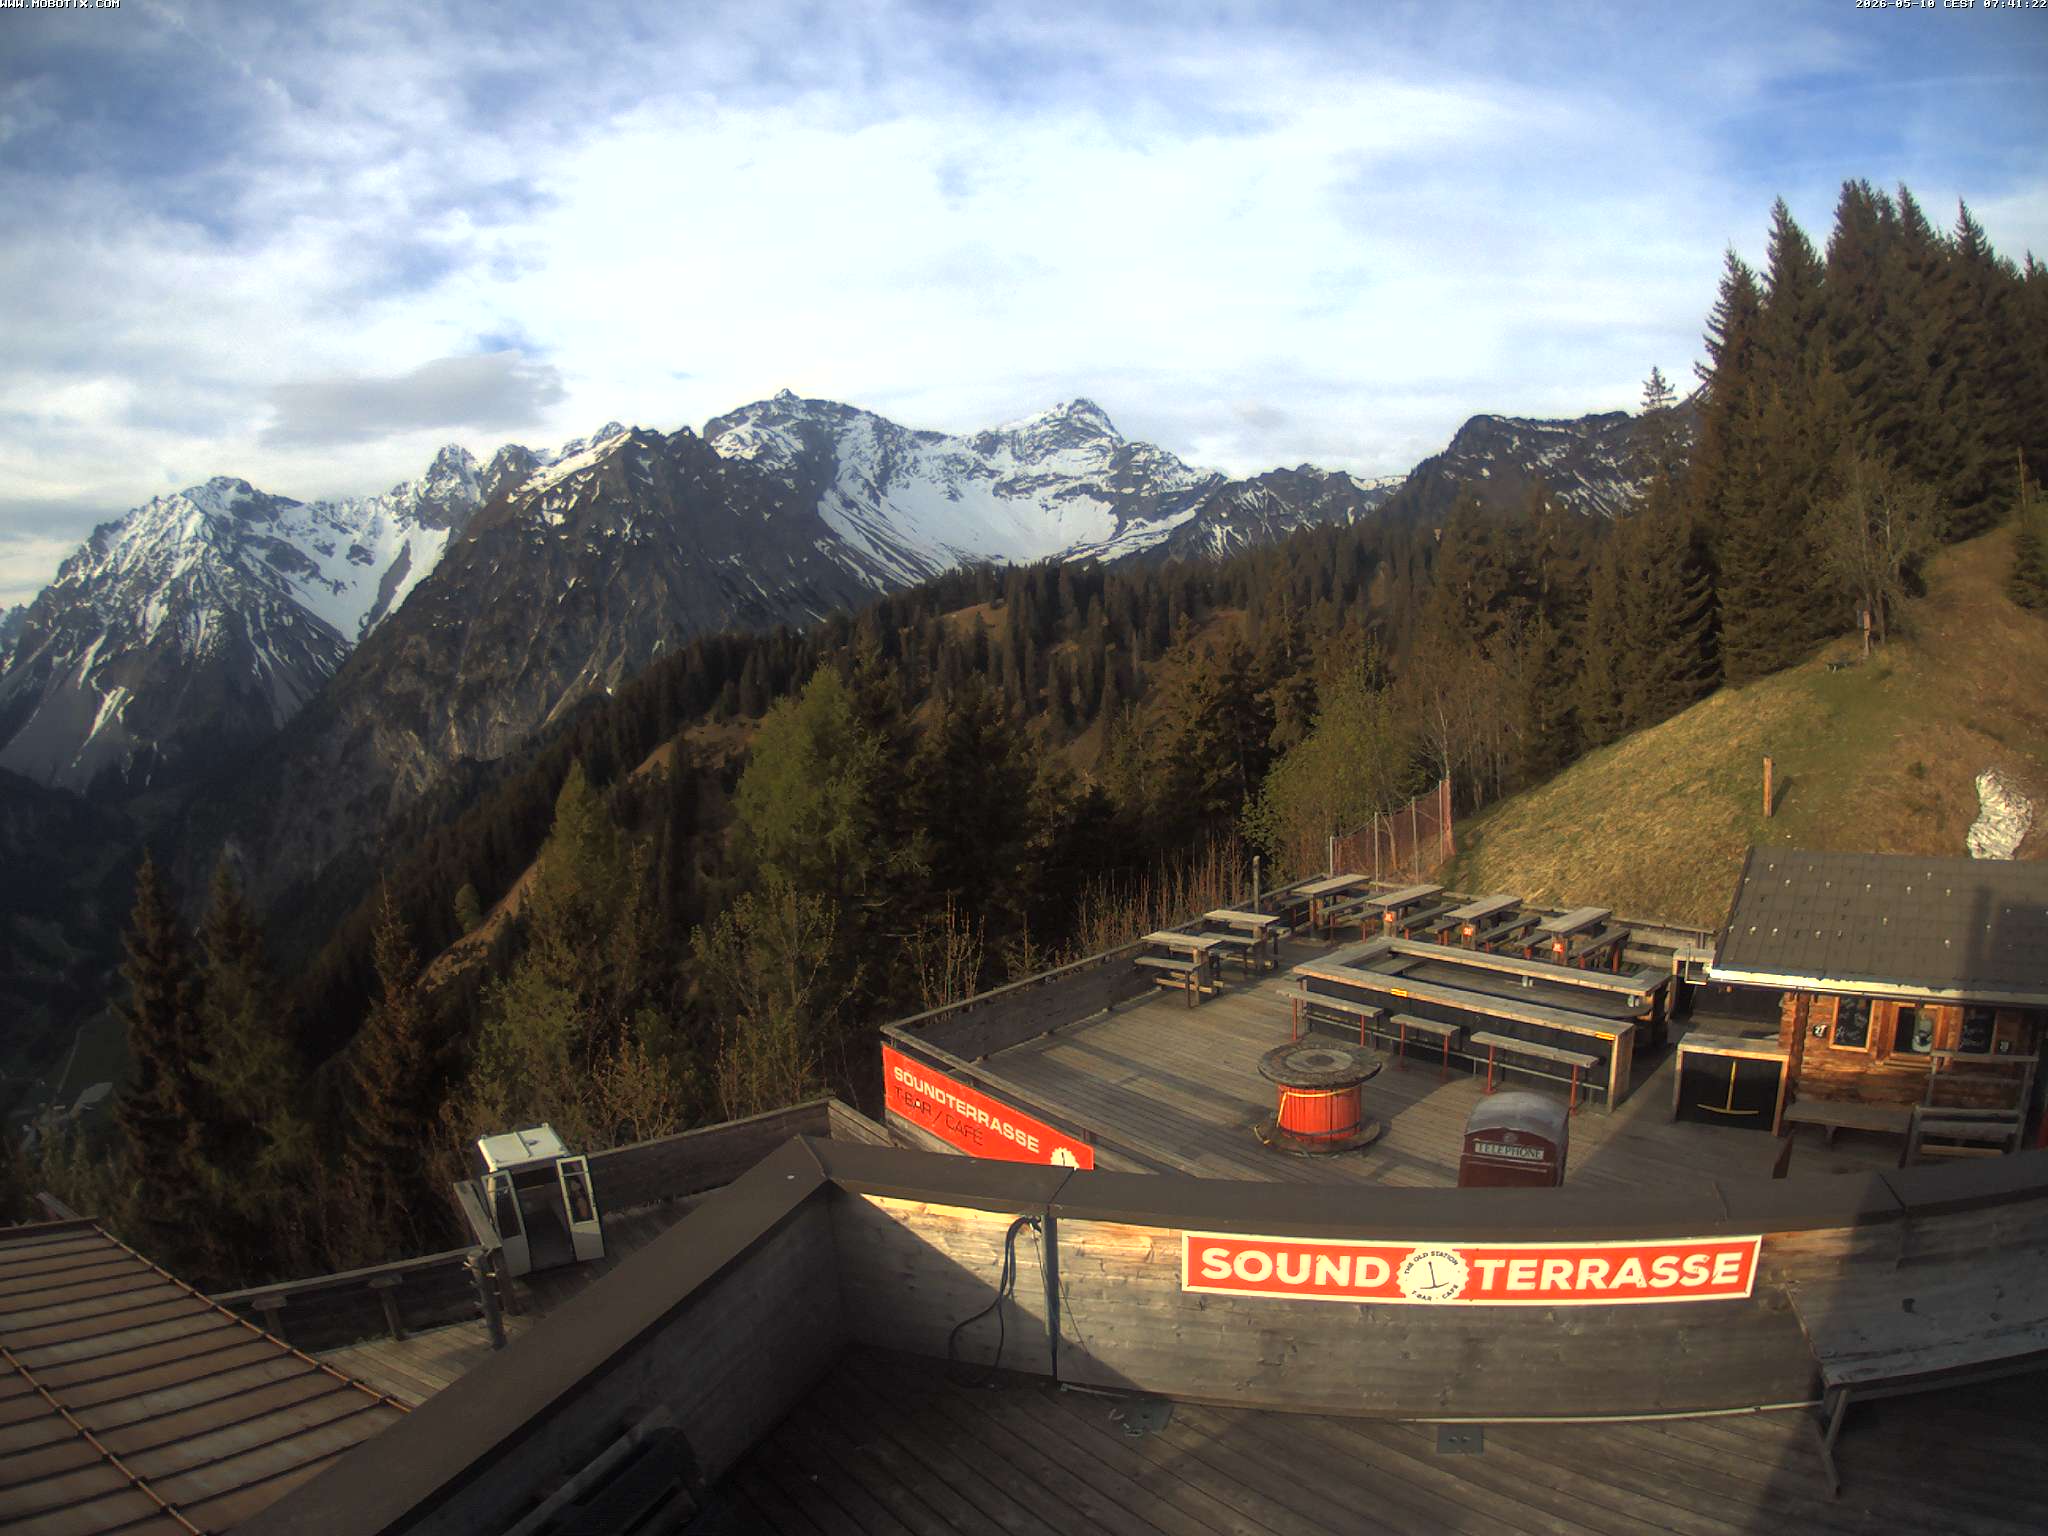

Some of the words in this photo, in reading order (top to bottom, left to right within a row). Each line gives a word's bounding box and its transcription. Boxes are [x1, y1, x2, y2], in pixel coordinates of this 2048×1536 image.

[894, 1066, 1040, 1154] SOUNDTERRASSE
[1477, 1143, 1542, 1159] TELEPHONE
[1201, 1247, 1391, 1288] SOUND
[1474, 1252, 1743, 1291] TERRASSE
[1404, 1262, 1414, 1274] THE
[1413, 1252, 1429, 1262] OLD
[1431, 1251, 1459, 1266] STATION
